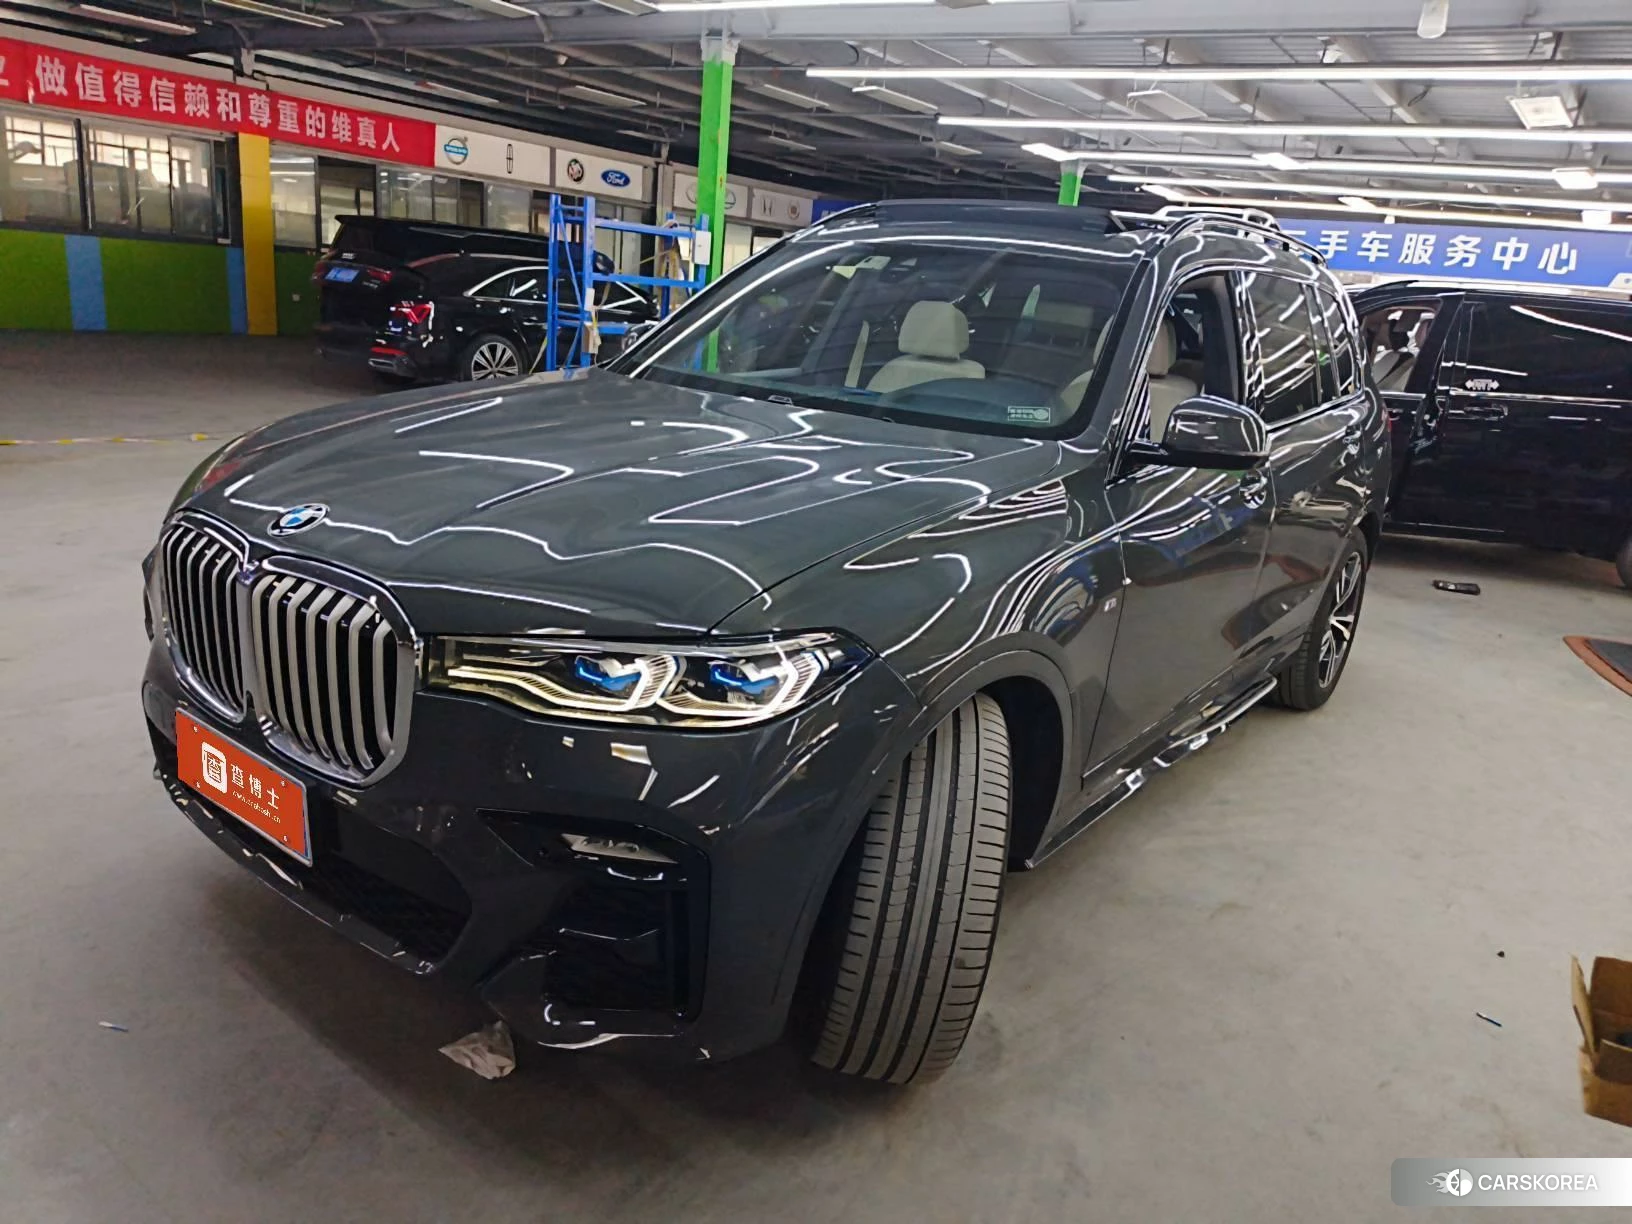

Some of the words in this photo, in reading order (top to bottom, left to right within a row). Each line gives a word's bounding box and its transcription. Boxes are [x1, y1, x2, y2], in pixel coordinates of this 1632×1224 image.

[35, 54, 401, 153] 做值得信赖和尊重的维真人
